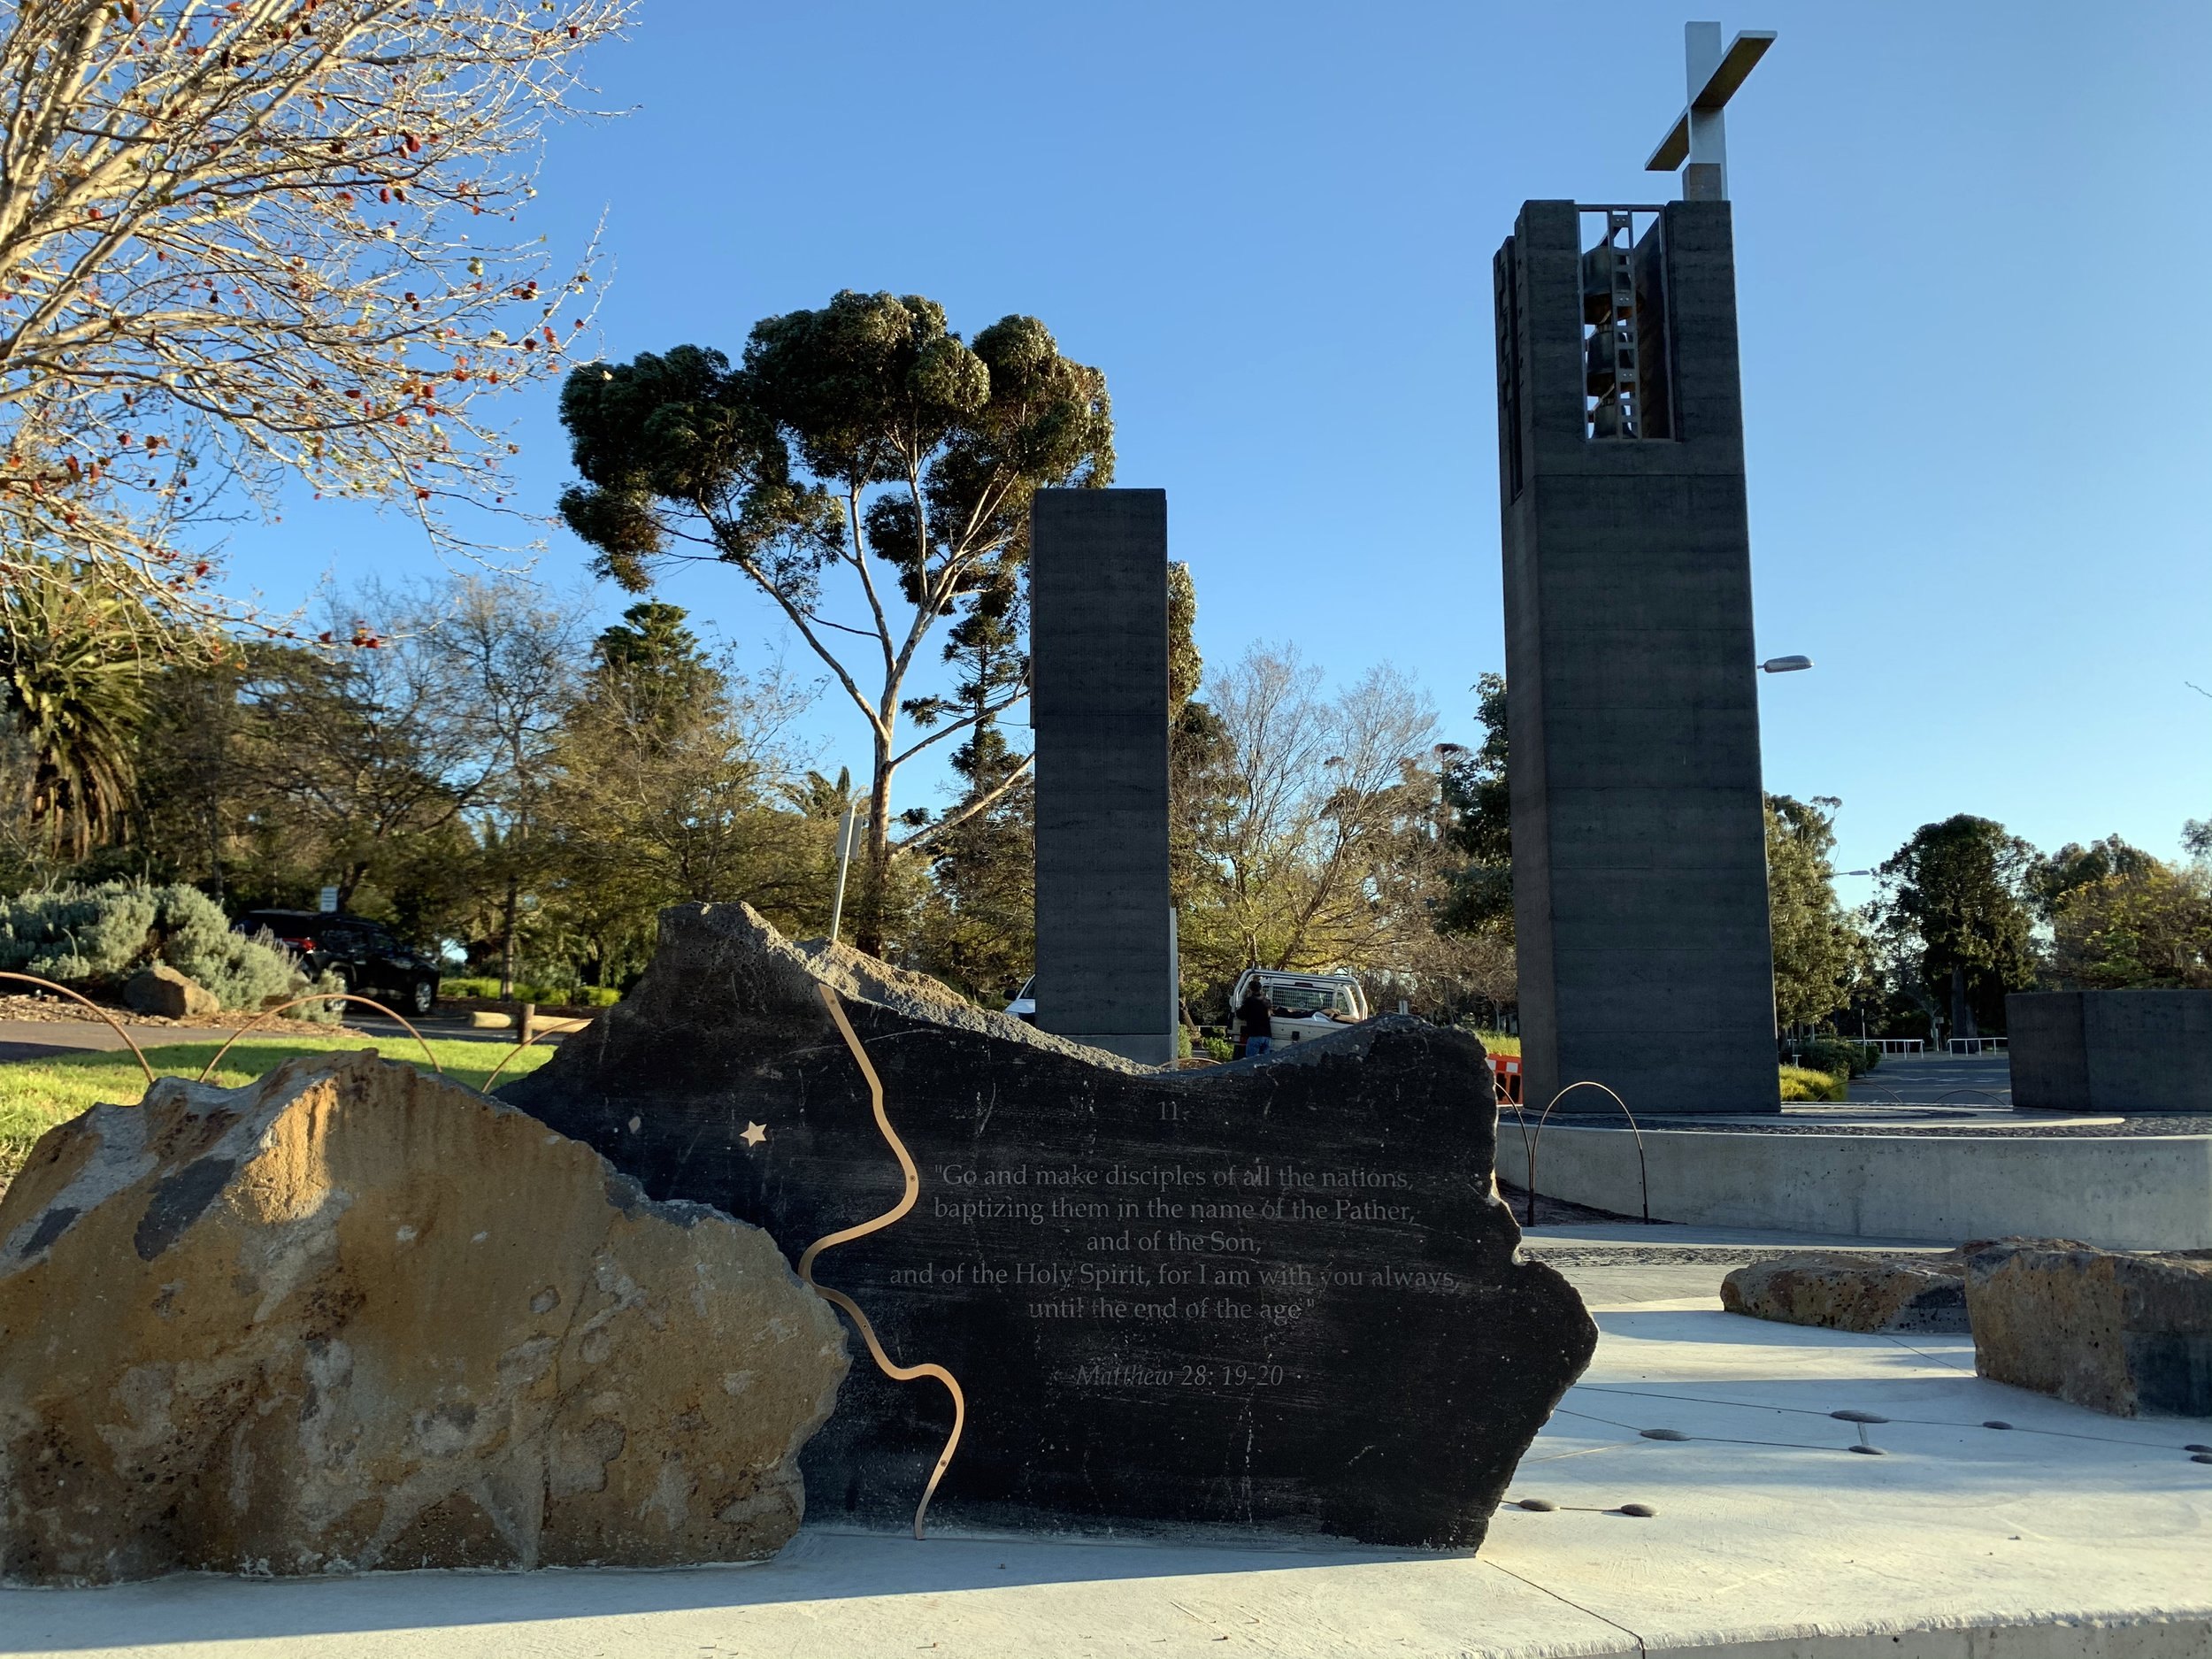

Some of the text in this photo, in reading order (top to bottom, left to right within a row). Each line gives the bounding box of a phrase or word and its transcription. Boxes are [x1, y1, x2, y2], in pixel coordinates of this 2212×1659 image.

[934, 1164, 1415, 1193] "Go and make disciples of all the nations,
[933, 1196, 1415, 1225] baptizing them in the name of the Father,
[1087, 1229, 1262, 1255] and of the Son,
[889, 1262, 1461, 1294] and of the Holy Spirit, for I am with you always,
[1027, 1297, 1085, 1319] until
[1091, 1296, 1127, 1318] the
[1133, 1296, 1178, 1318] end
[1185, 1296, 1210, 1319] of
[1216, 1296, 1253, 1319] the
[1074, 1364, 1285, 1386] Matthew 28: 19-20
